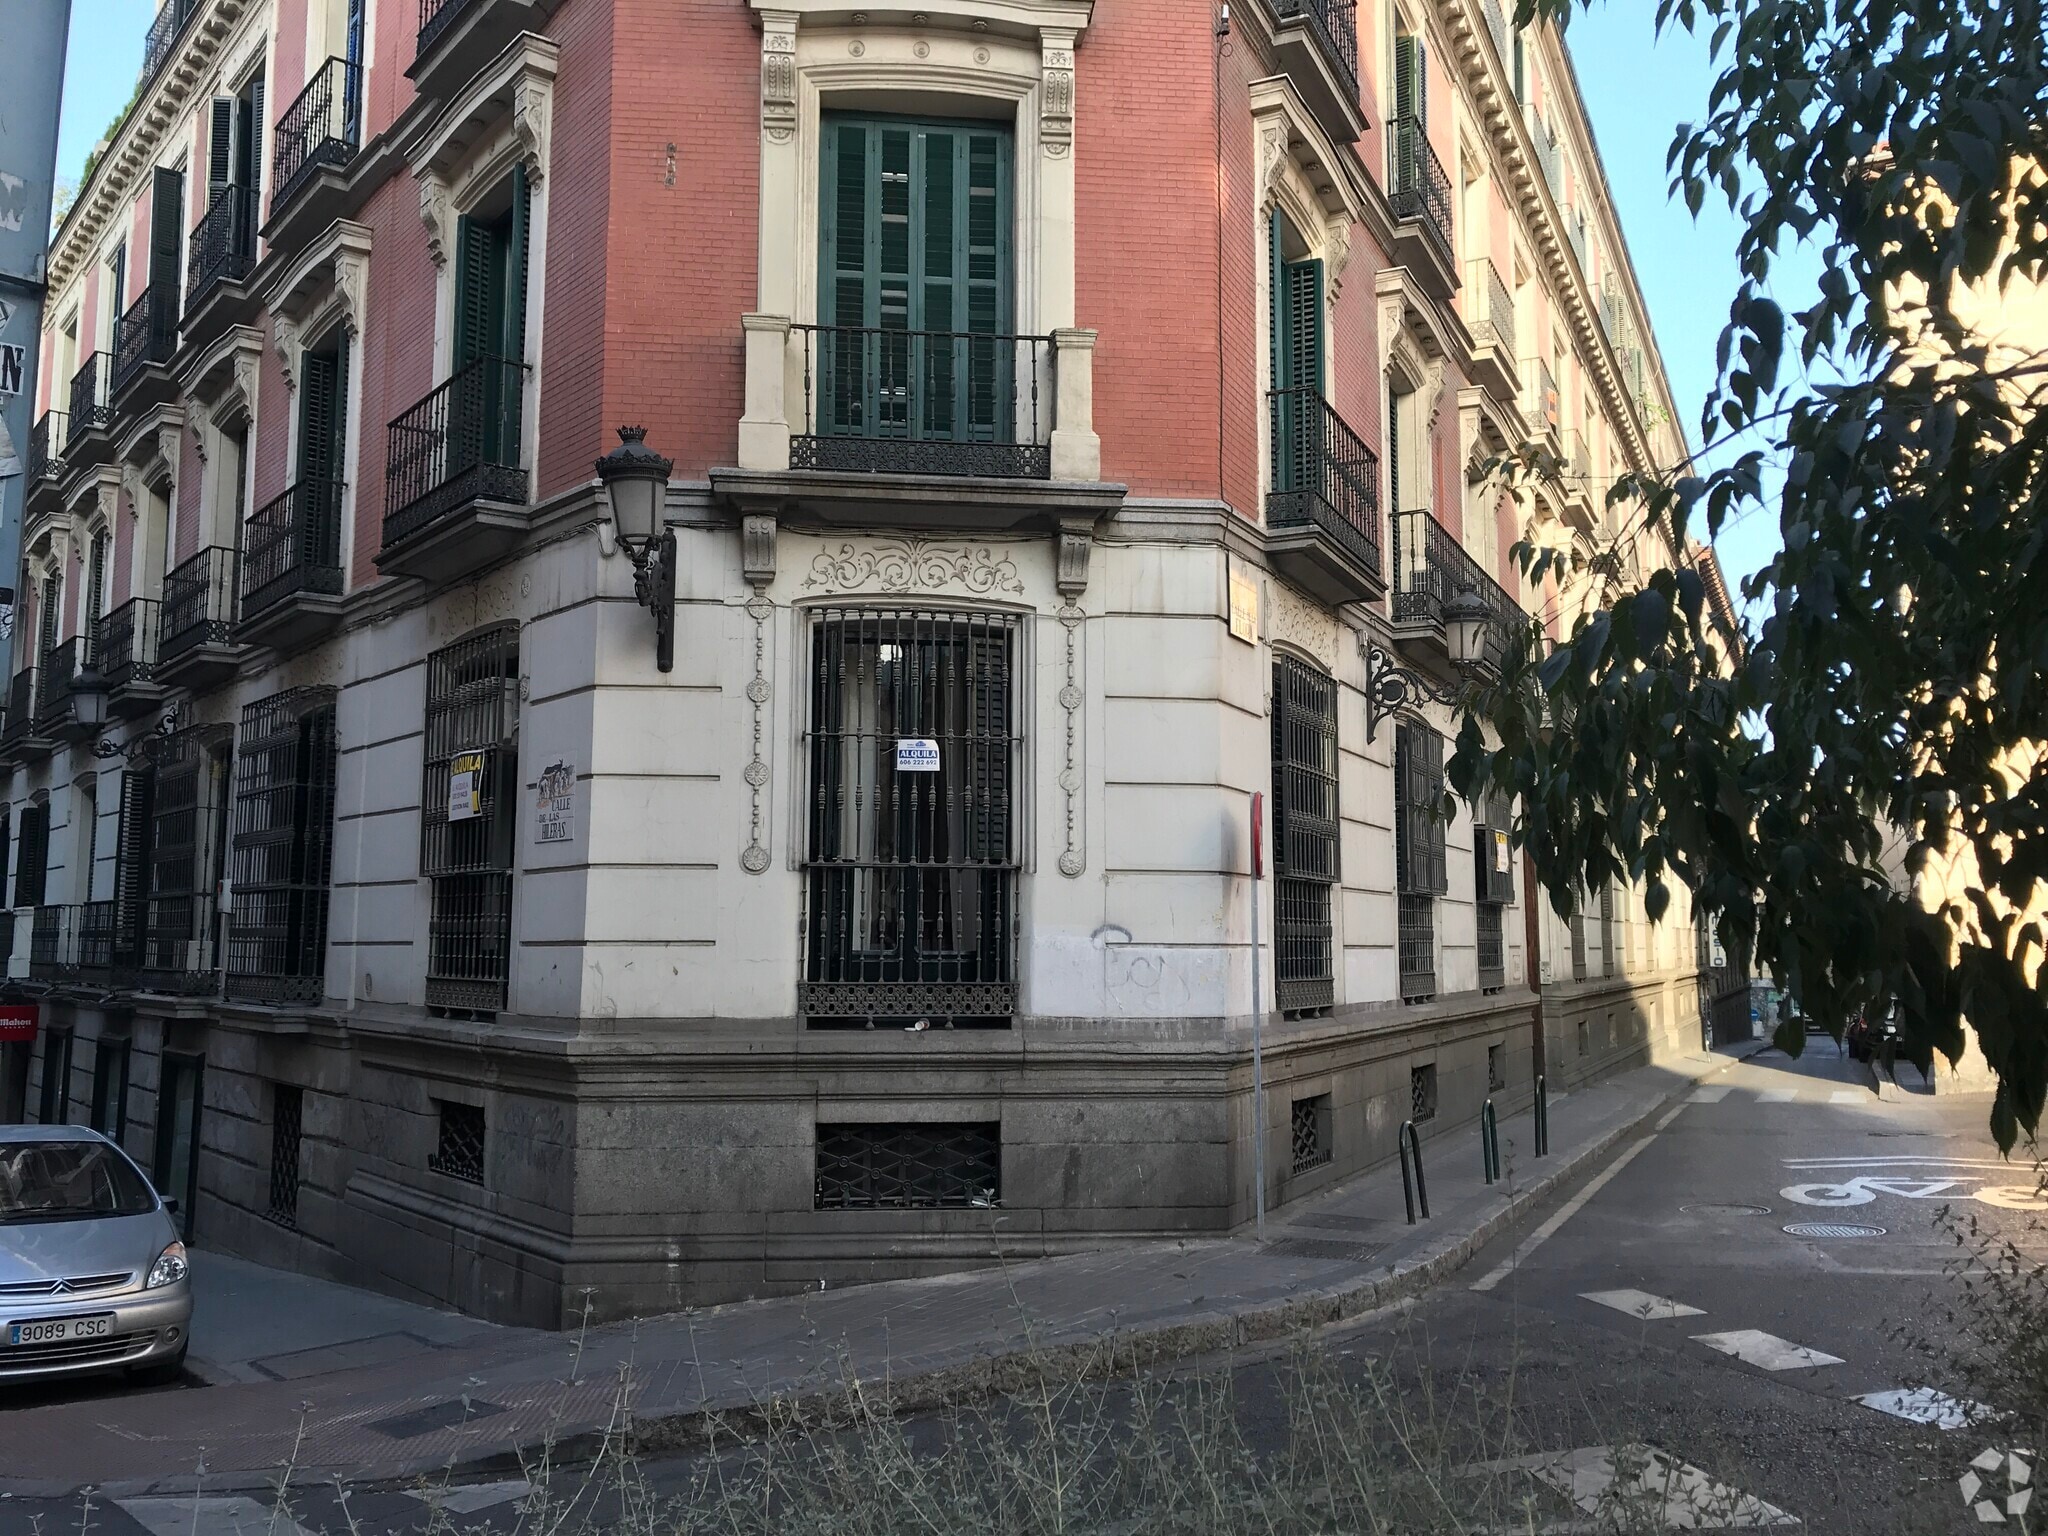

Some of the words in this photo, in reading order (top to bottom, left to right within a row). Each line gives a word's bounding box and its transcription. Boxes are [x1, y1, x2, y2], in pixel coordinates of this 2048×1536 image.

[900, 750, 937, 759] ALQUILA
[552, 798, 571, 811] CALLE
[549, 812, 560, 822] LAS
[541, 822, 567, 840] HILERAS
[22, 1323, 66, 1342] 9089
[75, 1319, 107, 1336] CSC
